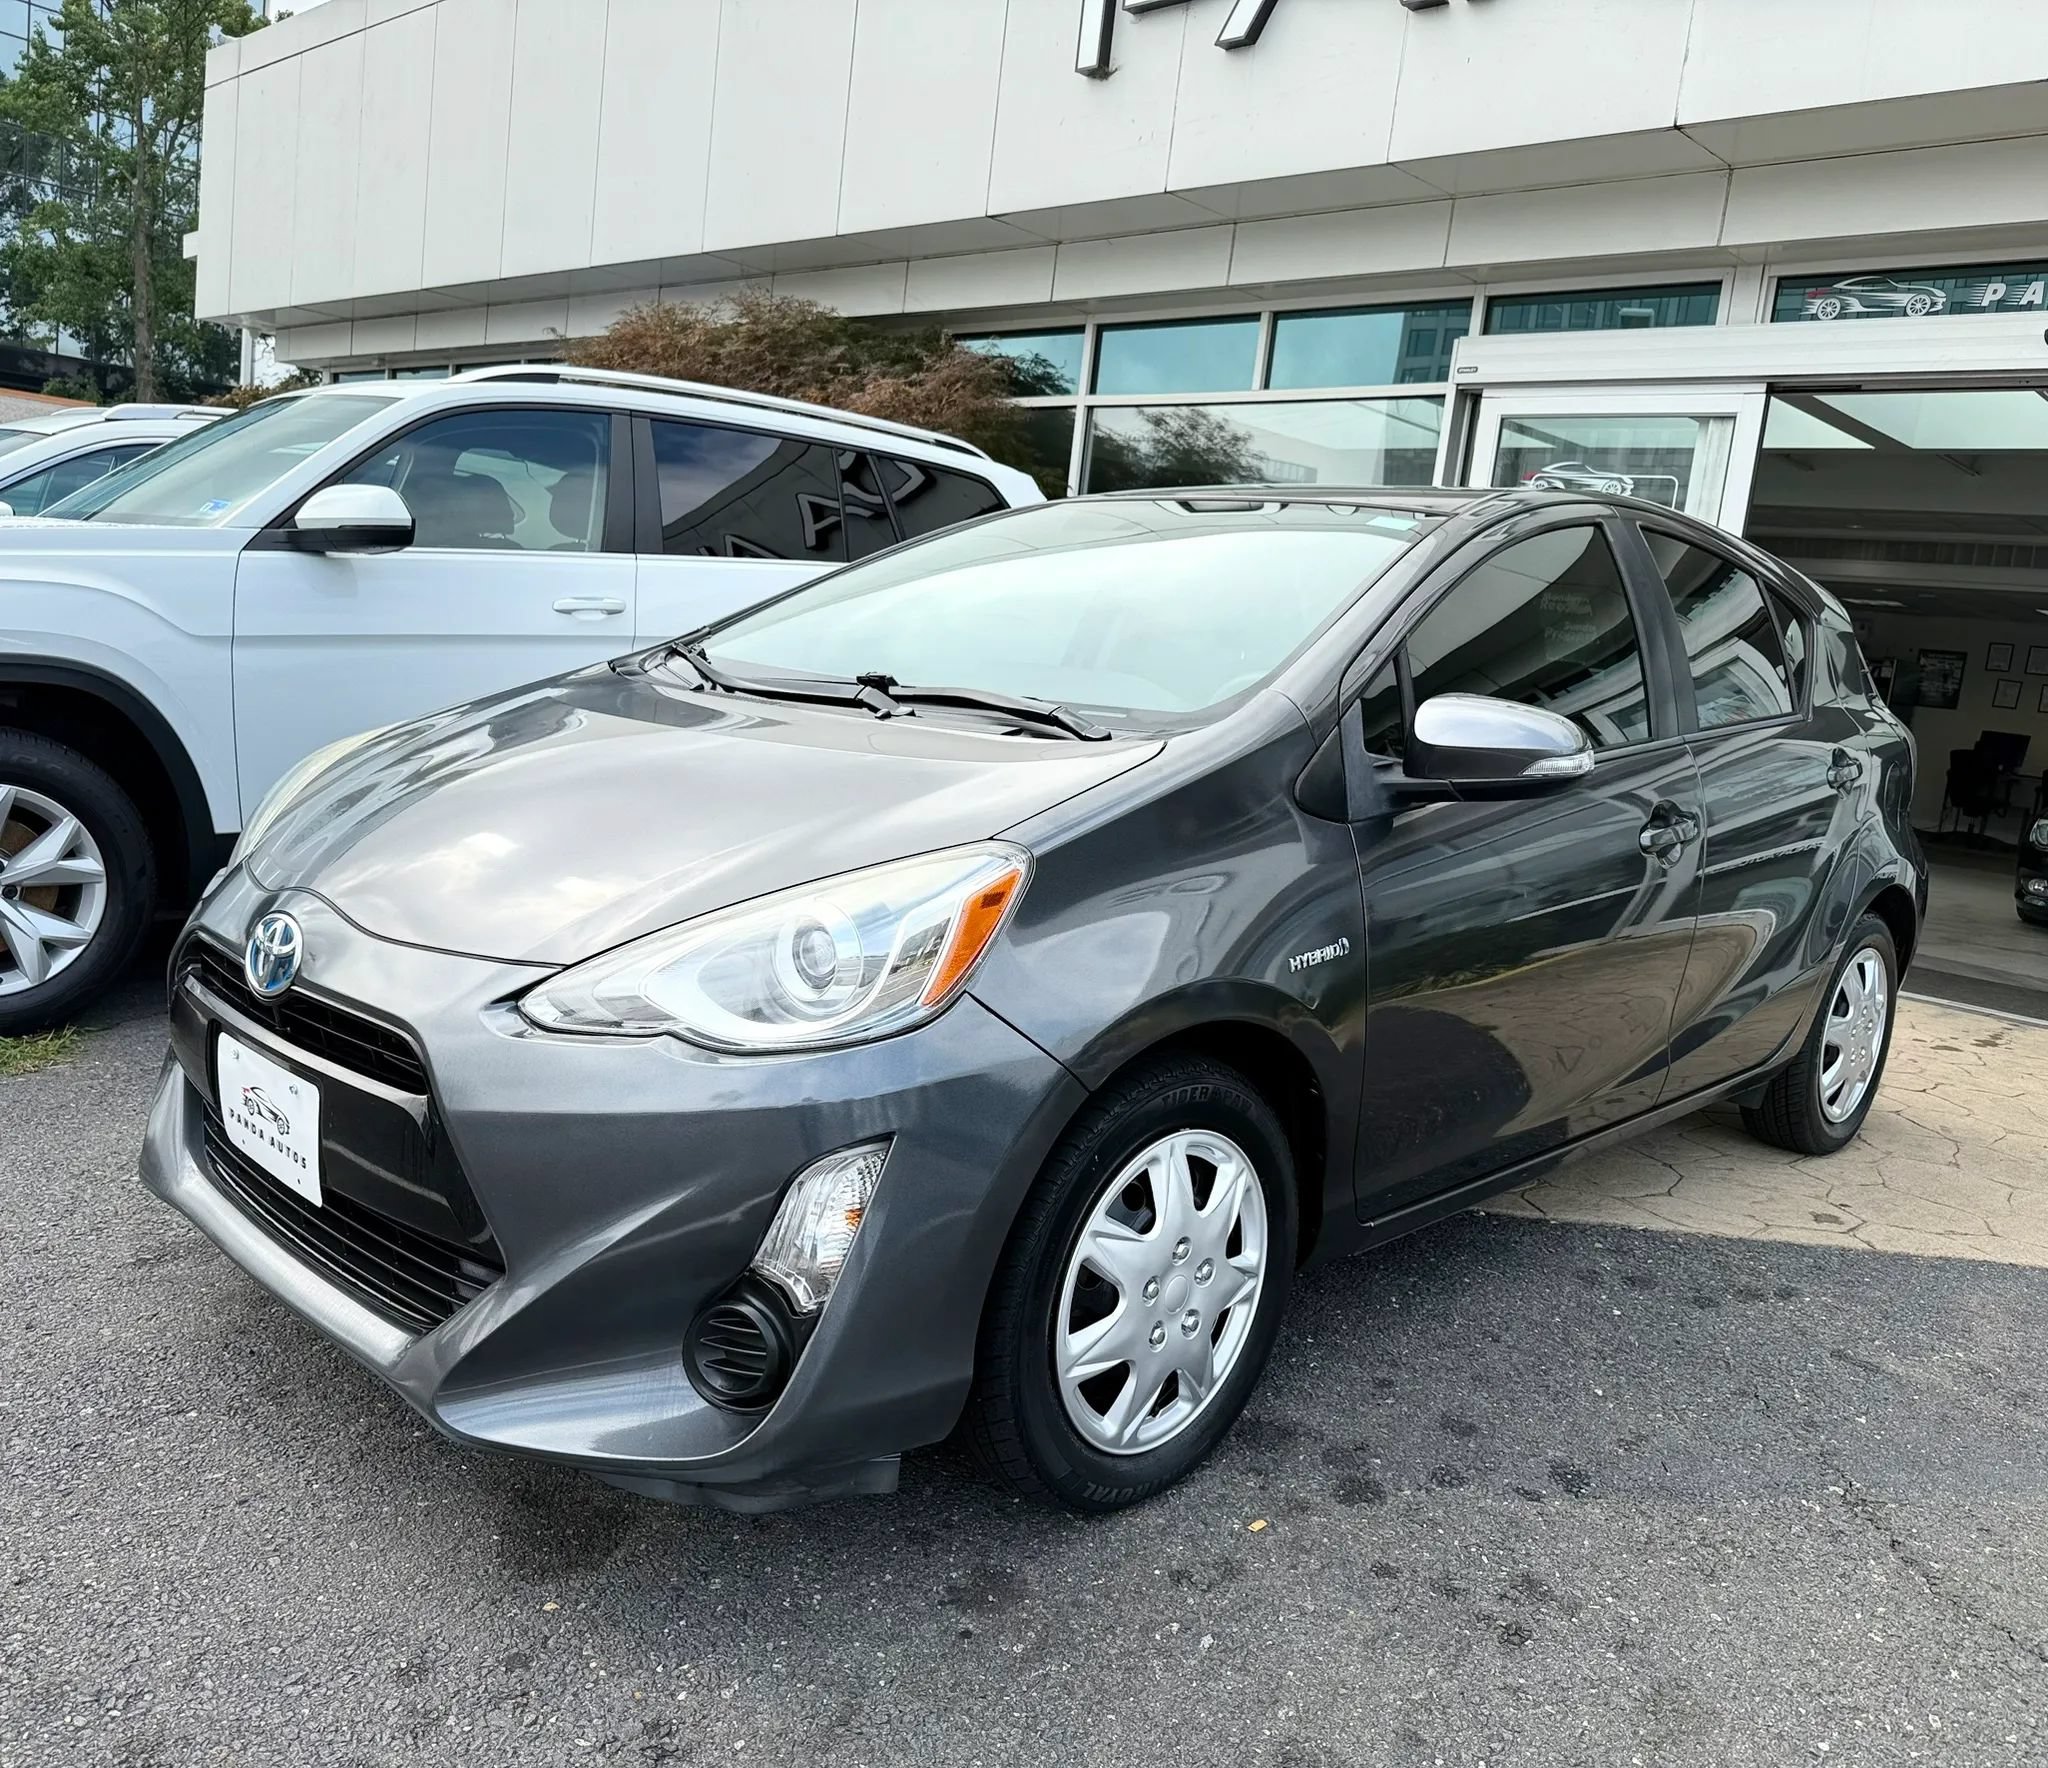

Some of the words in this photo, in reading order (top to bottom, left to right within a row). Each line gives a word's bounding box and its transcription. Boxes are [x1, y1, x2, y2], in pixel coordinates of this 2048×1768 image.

[1288, 943, 1340, 973] HYBRID
[228, 1106, 265, 1141] PANDA
[269, 1136, 307, 1169] AUTOS
